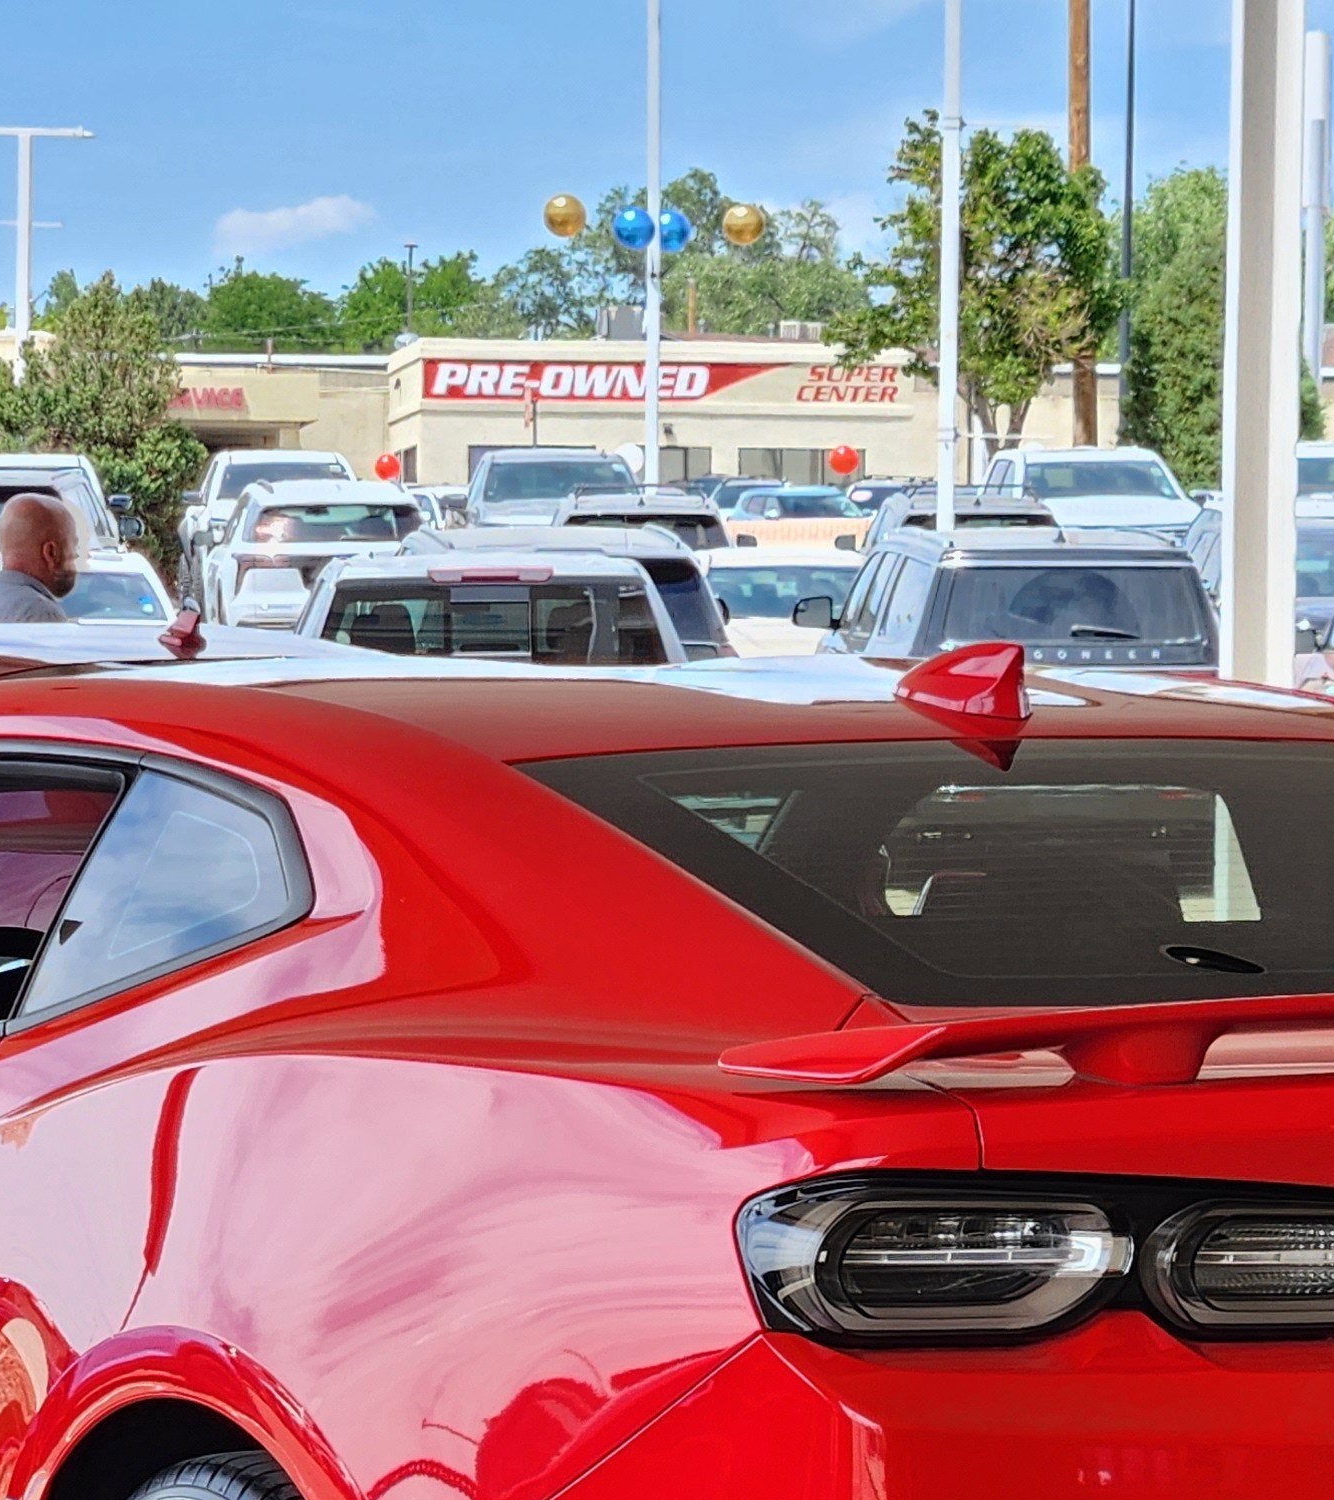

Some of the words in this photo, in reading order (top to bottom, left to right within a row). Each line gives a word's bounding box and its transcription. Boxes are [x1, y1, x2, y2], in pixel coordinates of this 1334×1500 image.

[432, 362, 710, 398] PRE-OWNED
[808, 365, 899, 383] SUPER
[796, 385, 899, 403] CENTER
[1033, 648, 1161, 660] GONEER
